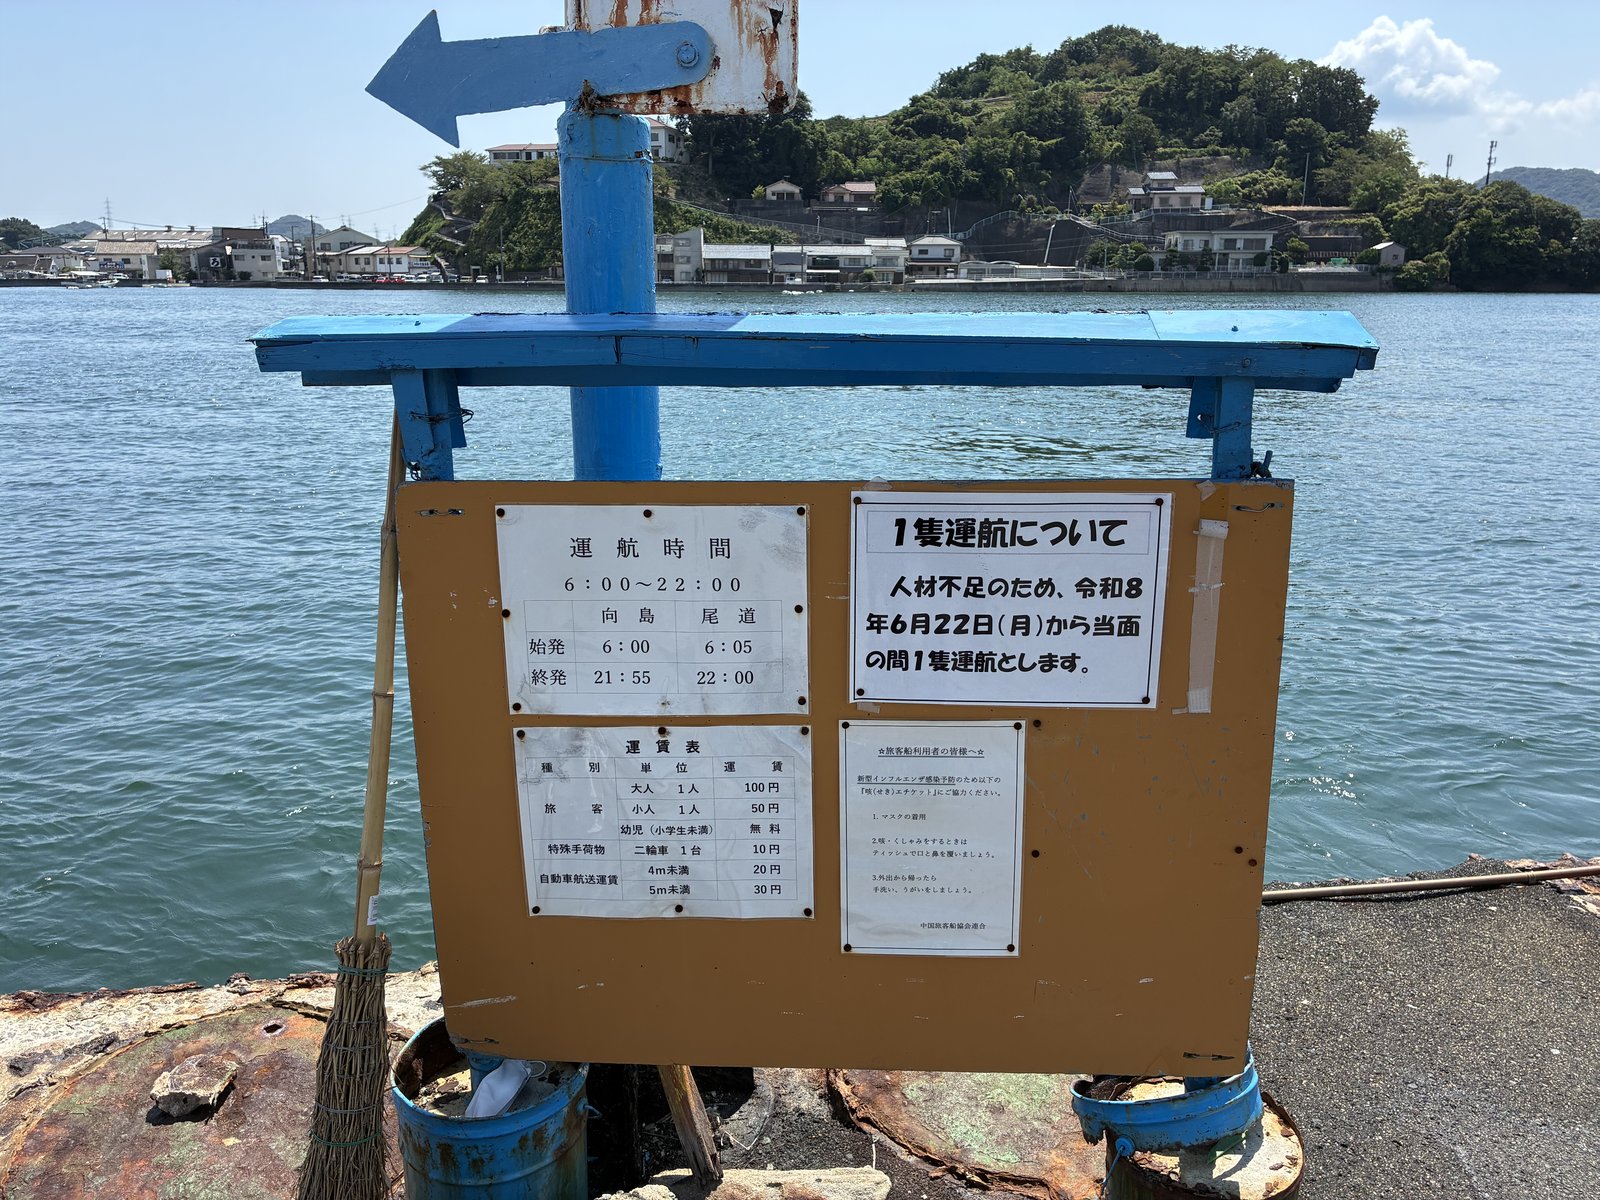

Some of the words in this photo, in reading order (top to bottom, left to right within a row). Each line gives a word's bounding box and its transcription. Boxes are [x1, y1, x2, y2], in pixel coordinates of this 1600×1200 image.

[895, 518, 1127, 548] 1隻運航について
[570, 537, 730, 559] 運航時間
[890, 575, 1143, 599] 人材不足のため、令和8
[602, 607, 654, 624] 向島
[702, 608, 756, 624] 尾道
[866, 613, 1141, 637] 年6月22日(月)から当面
[529, 639, 565, 655] 始発
[603, 640, 649, 653] 6：00
[705, 640, 752, 654] 6：05
[866, 650, 1088, 673] の間1隻運航とします。
[532, 669, 566, 685] 終発
[594, 671, 650, 684] 21：55
[697, 671, 753, 684] 22：00
[626, 740, 700, 754] 運賃表
[541, 762, 600, 774] 種別
[641, 762, 688, 773] 単位
[724, 761, 783, 772] 運賃
[631, 783, 654, 794] 大人
[678, 784, 699, 793] 1人
[745, 782, 779, 793] 100円
[545, 803, 602, 814] 旅客
[632, 804, 655, 814] 小人
[679, 804, 700, 814] 1人
[752, 803, 779, 813] 50円
[620, 824, 714, 835] 幼児（小学生未満）
[750, 824, 780, 834] 無料
[548, 844, 605, 855] 特殊手荷物
[634, 845, 668, 855] 二輪車
[681, 845, 701, 855] 1台
[753, 844, 779, 854] 10円
[648, 865, 689, 875] 4m未満
[754, 865, 780, 874] 20円
[540, 874, 618, 885] 自動車航送運賃
[650, 885, 690, 895] 5m未満
[754, 885, 781, 894] 30円
[920, 921, 986, 930] 中国旅客船協会連合
